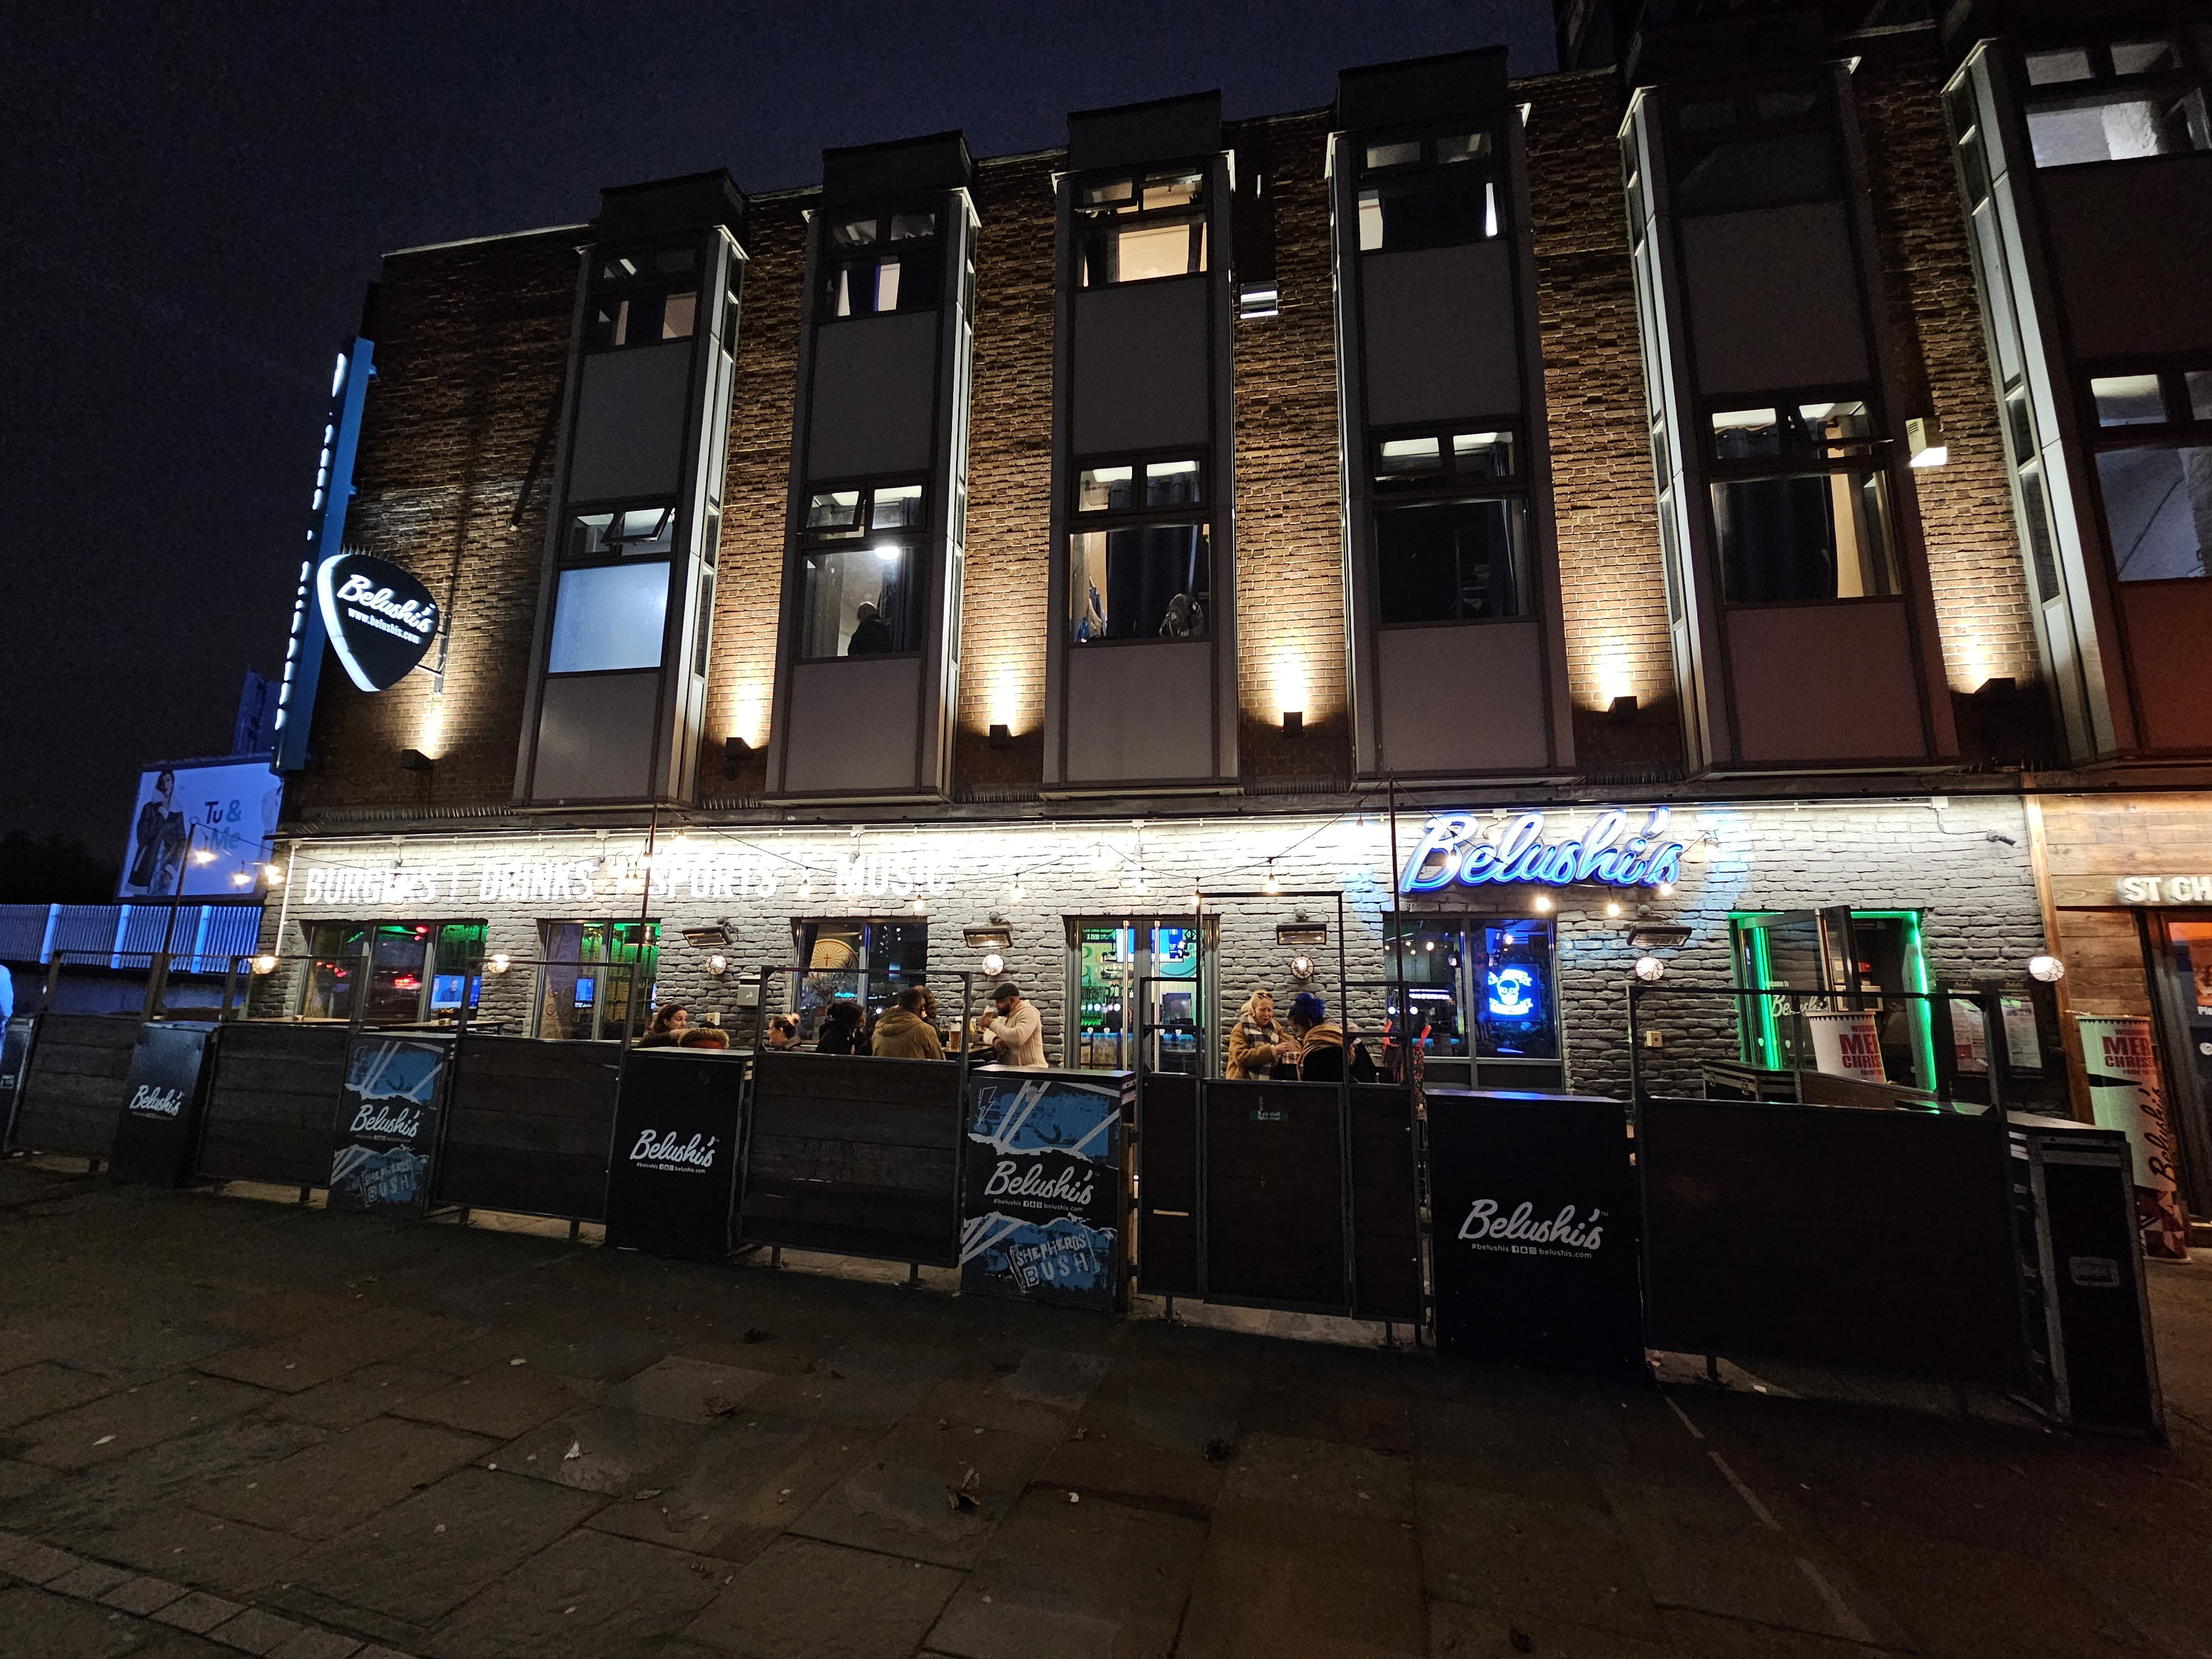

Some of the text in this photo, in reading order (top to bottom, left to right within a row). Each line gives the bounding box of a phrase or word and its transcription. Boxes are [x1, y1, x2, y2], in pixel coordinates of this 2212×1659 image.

[337, 574, 436, 633] Belushi's
[348, 607, 421, 644] www.belushis.com
[205, 800, 241, 824] Tu &
[210, 827, 241, 850] Me
[1400, 806, 1683, 895] Belushi's
[479, 861, 595, 901] DRINKS
[648, 854, 778, 899] SPORTS
[834, 854, 949, 897] MUSIC
[2124, 877, 2161, 901] ST
[129, 1084, 182, 1116] Belushi's
[350, 1104, 420, 1138] Belushi's
[630, 1129, 715, 1167] Belushi's
[985, 1161, 1094, 1204] Belushi's
[993, 1198, 1083, 1212] #belushis belushis.com
[1458, 1199, 1604, 1250] Belushi's
[1472, 1243, 1592, 1259] #belushis belushis.com
[1023, 1253, 1089, 1286] BUSH
